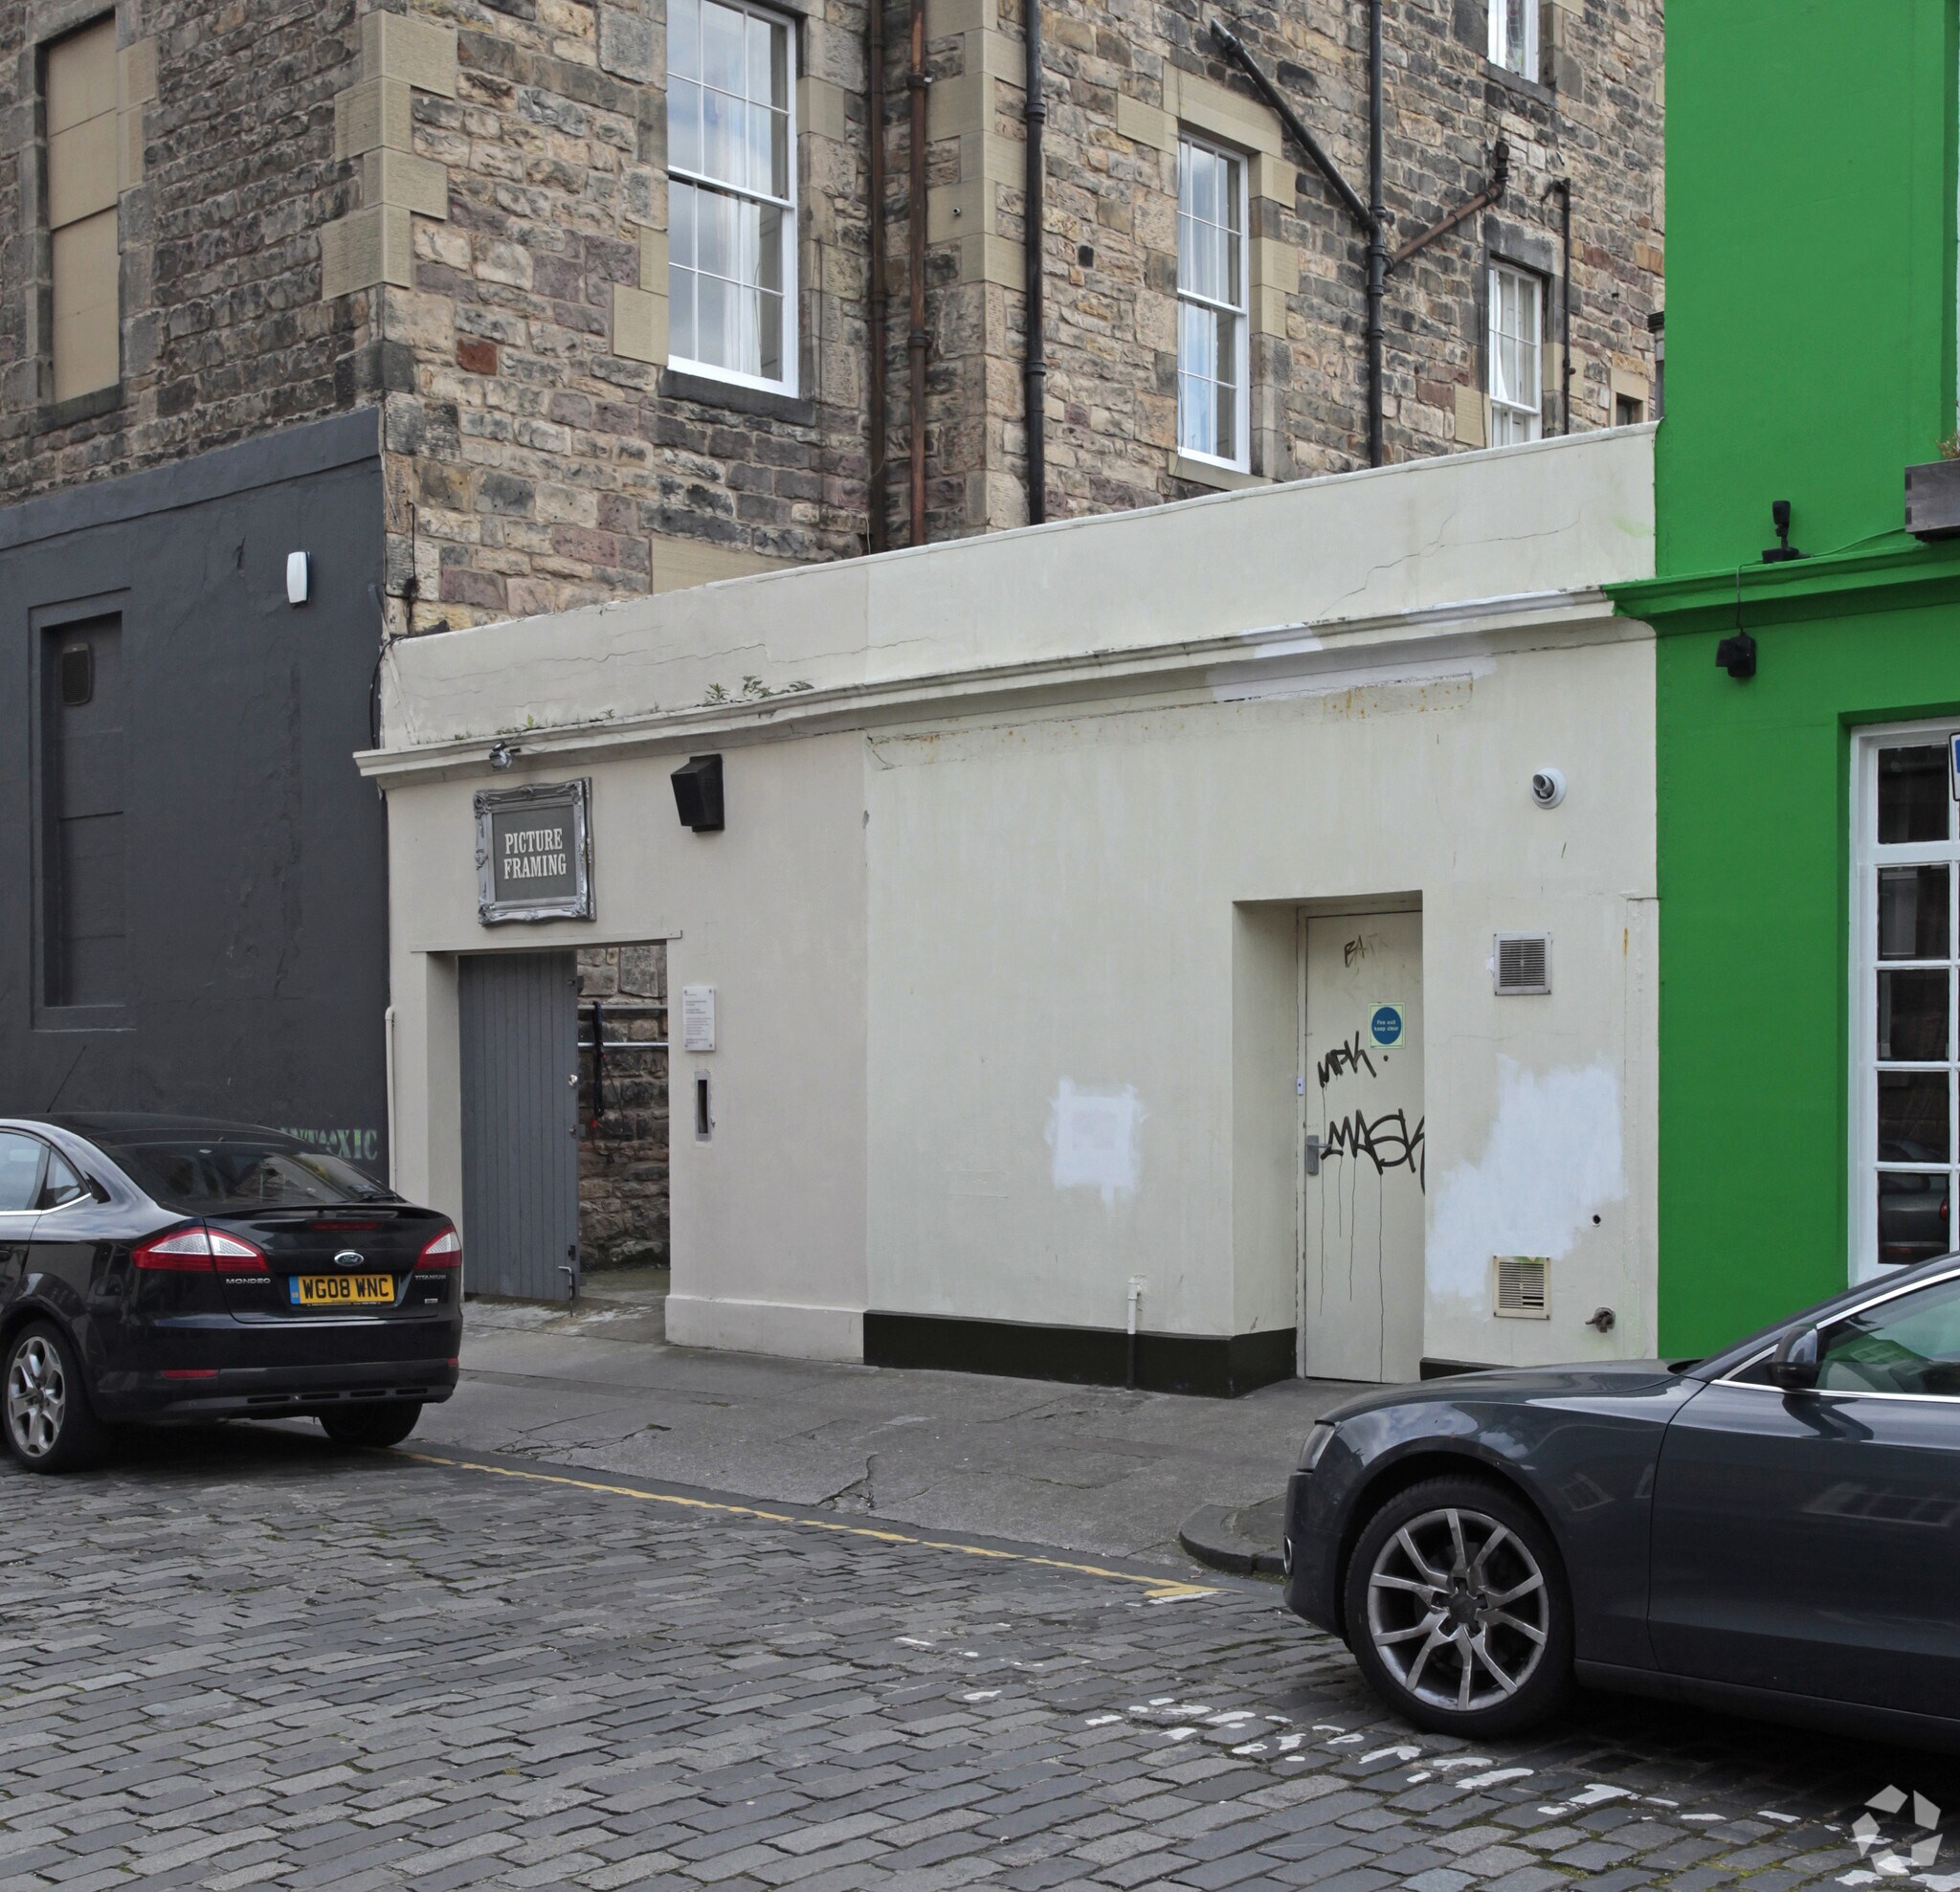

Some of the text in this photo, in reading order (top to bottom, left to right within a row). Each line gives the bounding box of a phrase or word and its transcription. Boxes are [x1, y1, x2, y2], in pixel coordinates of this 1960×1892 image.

[504, 828, 563, 855] PICTURE
[503, 854, 567, 879] FRAMING
[302, 1278, 390, 1300] WG08 WNC
